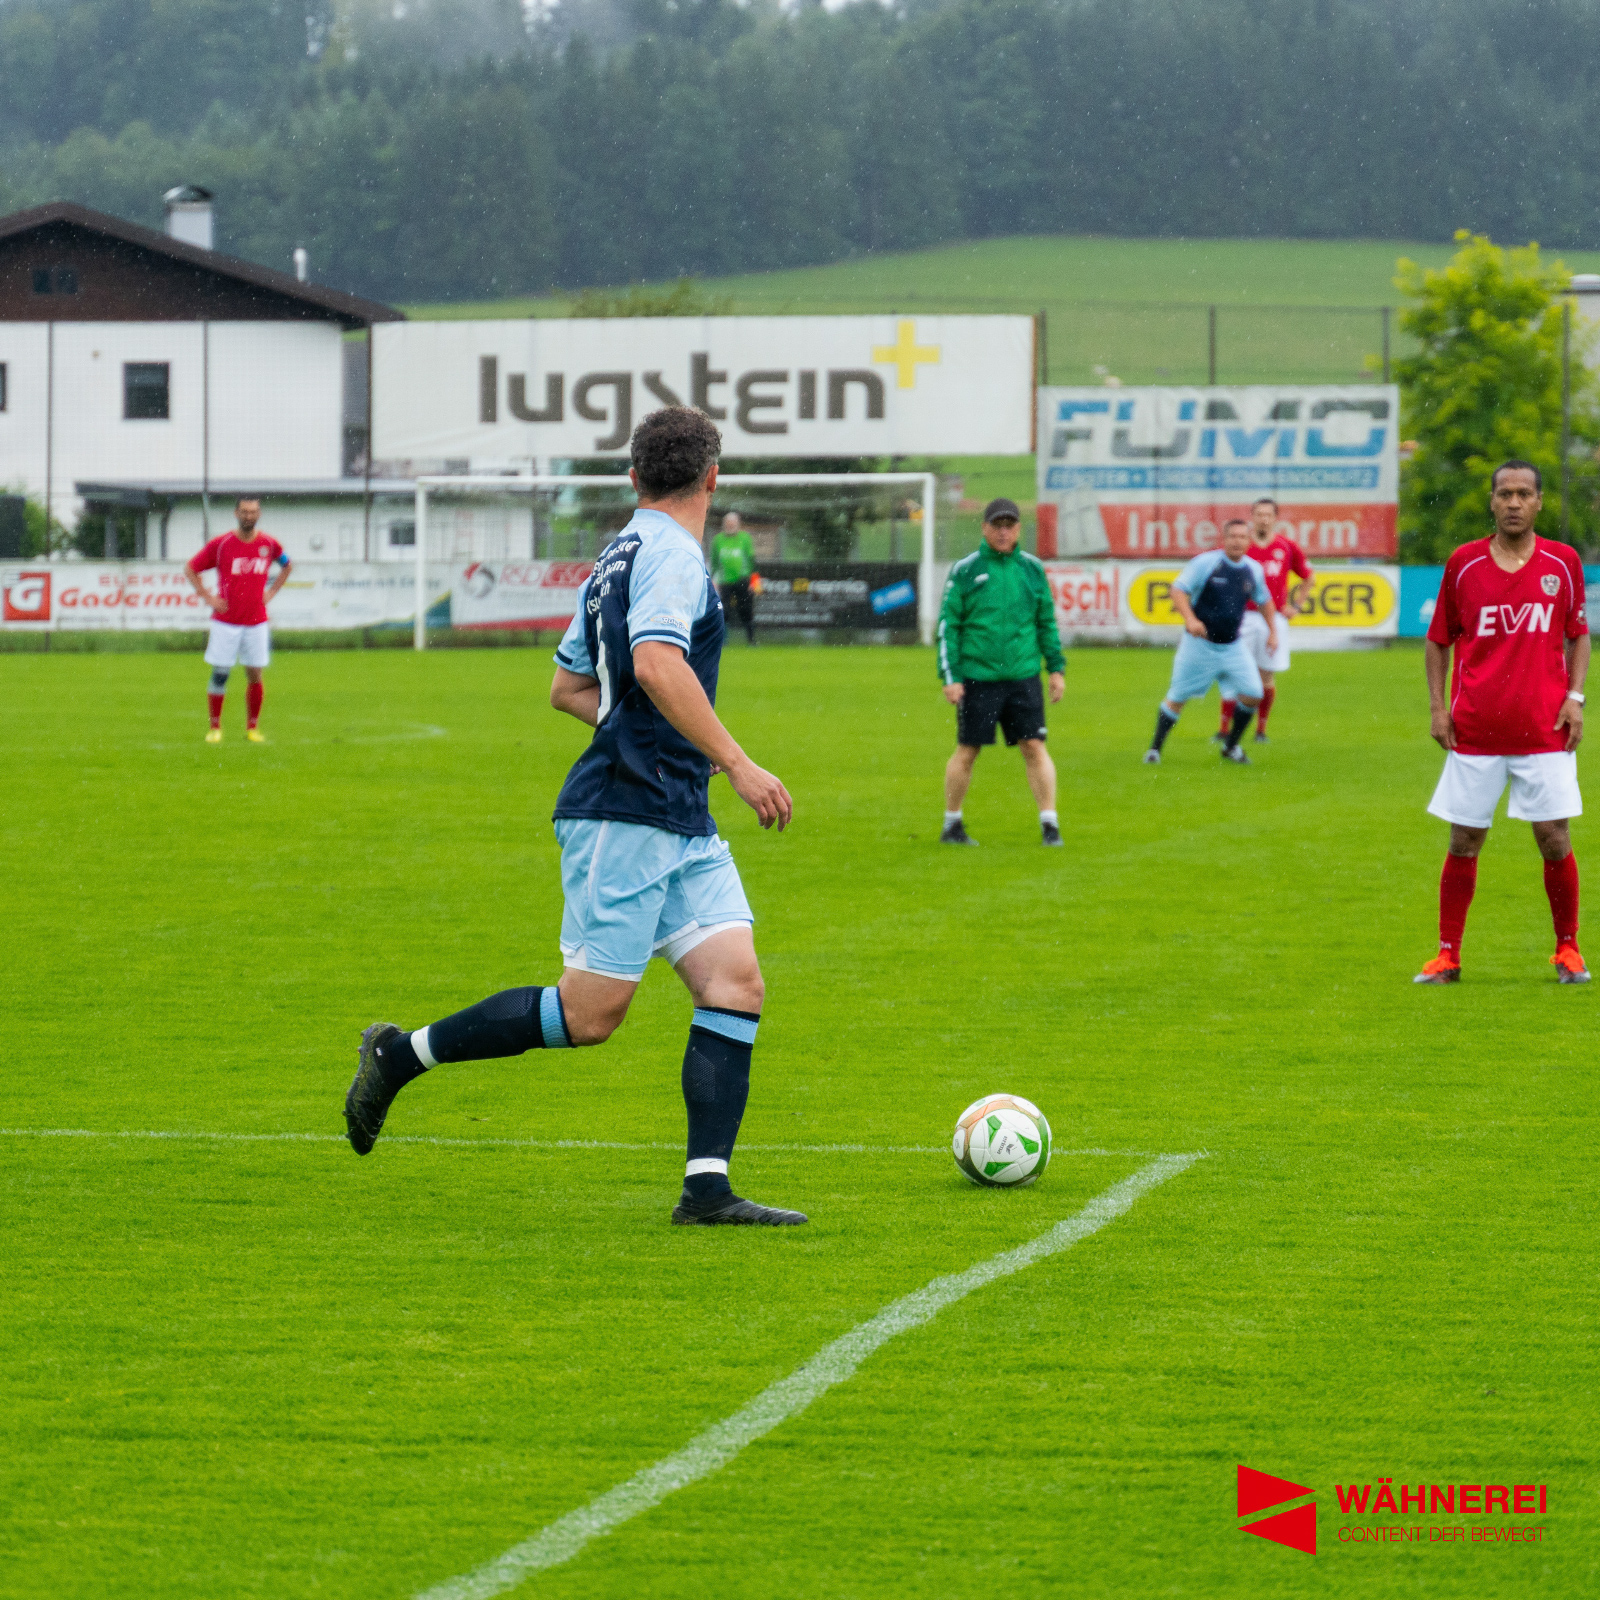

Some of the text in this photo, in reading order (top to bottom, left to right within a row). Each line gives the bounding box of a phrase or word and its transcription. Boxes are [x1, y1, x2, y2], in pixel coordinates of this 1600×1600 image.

[1052, 399, 1390, 458] FUMO
[1127, 512, 1358, 549] Inteorm
[1477, 603, 1554, 637] EVN
